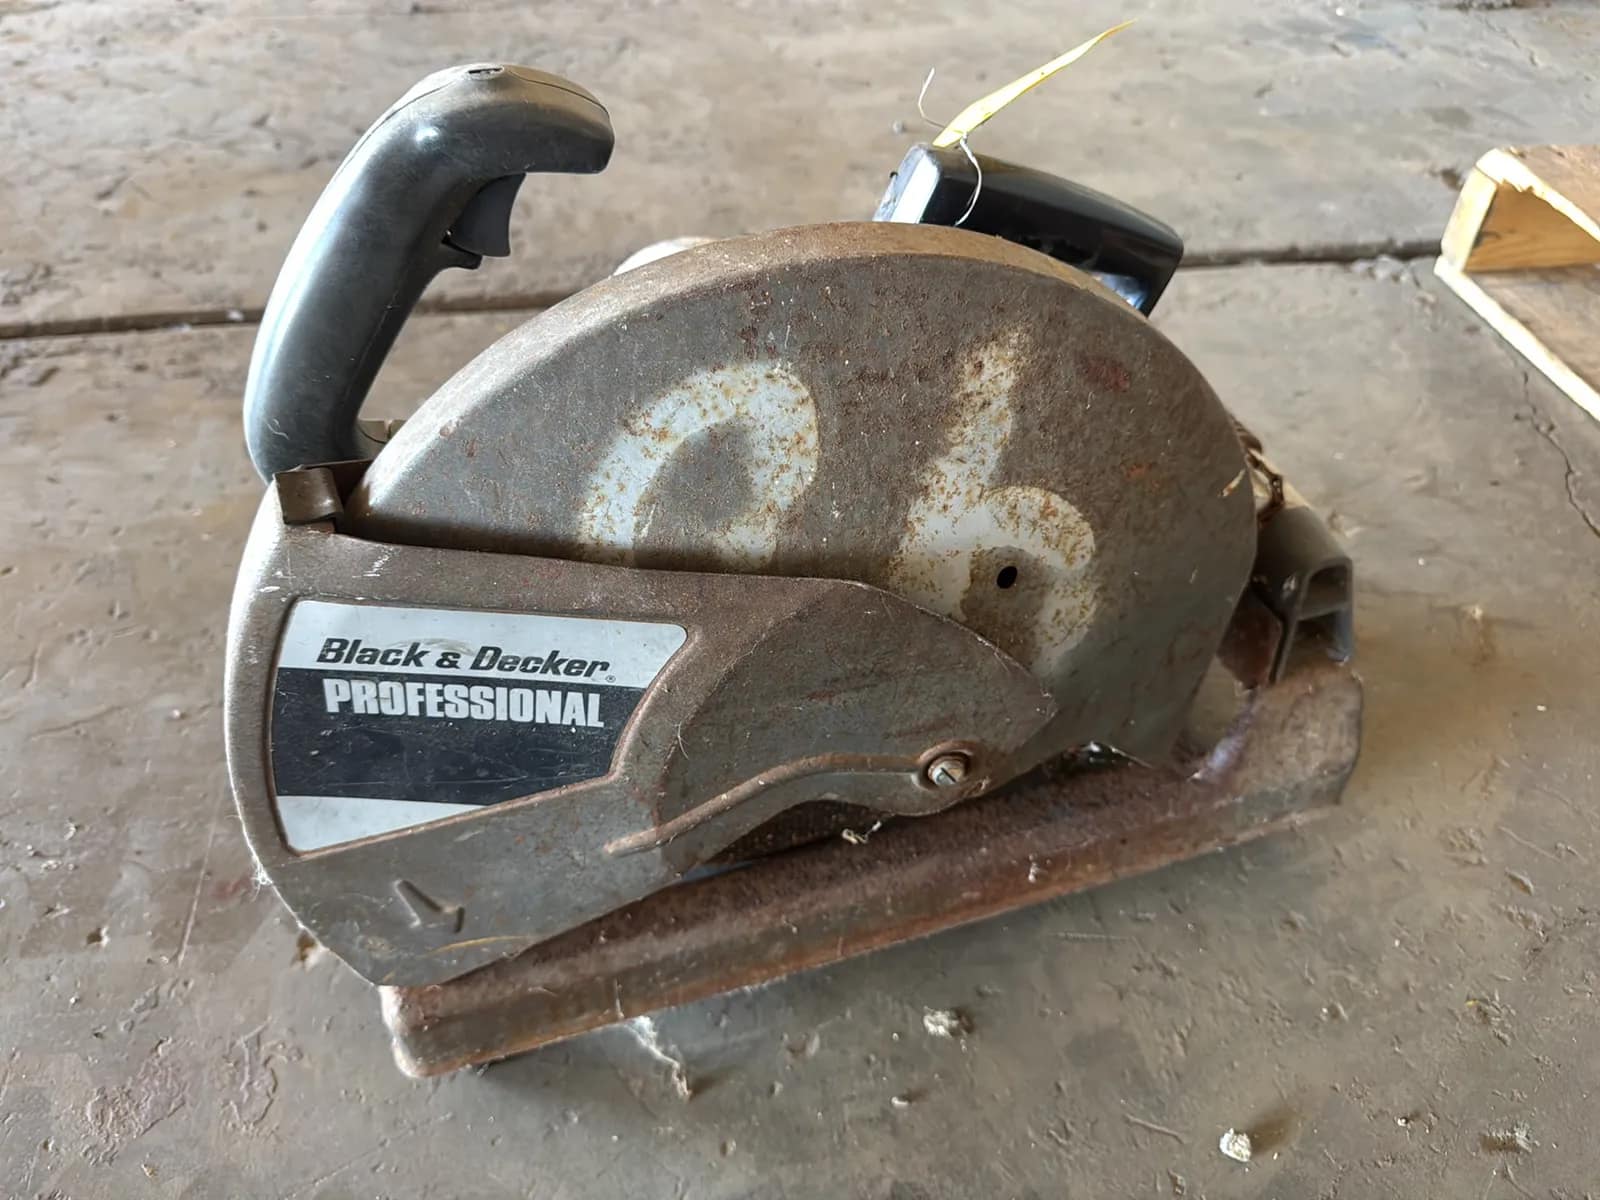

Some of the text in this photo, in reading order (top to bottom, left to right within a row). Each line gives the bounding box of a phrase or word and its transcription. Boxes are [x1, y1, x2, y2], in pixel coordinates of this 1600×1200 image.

[316, 637, 611, 678] Black & Decker
[322, 678, 605, 728] PROFESSIONAL
